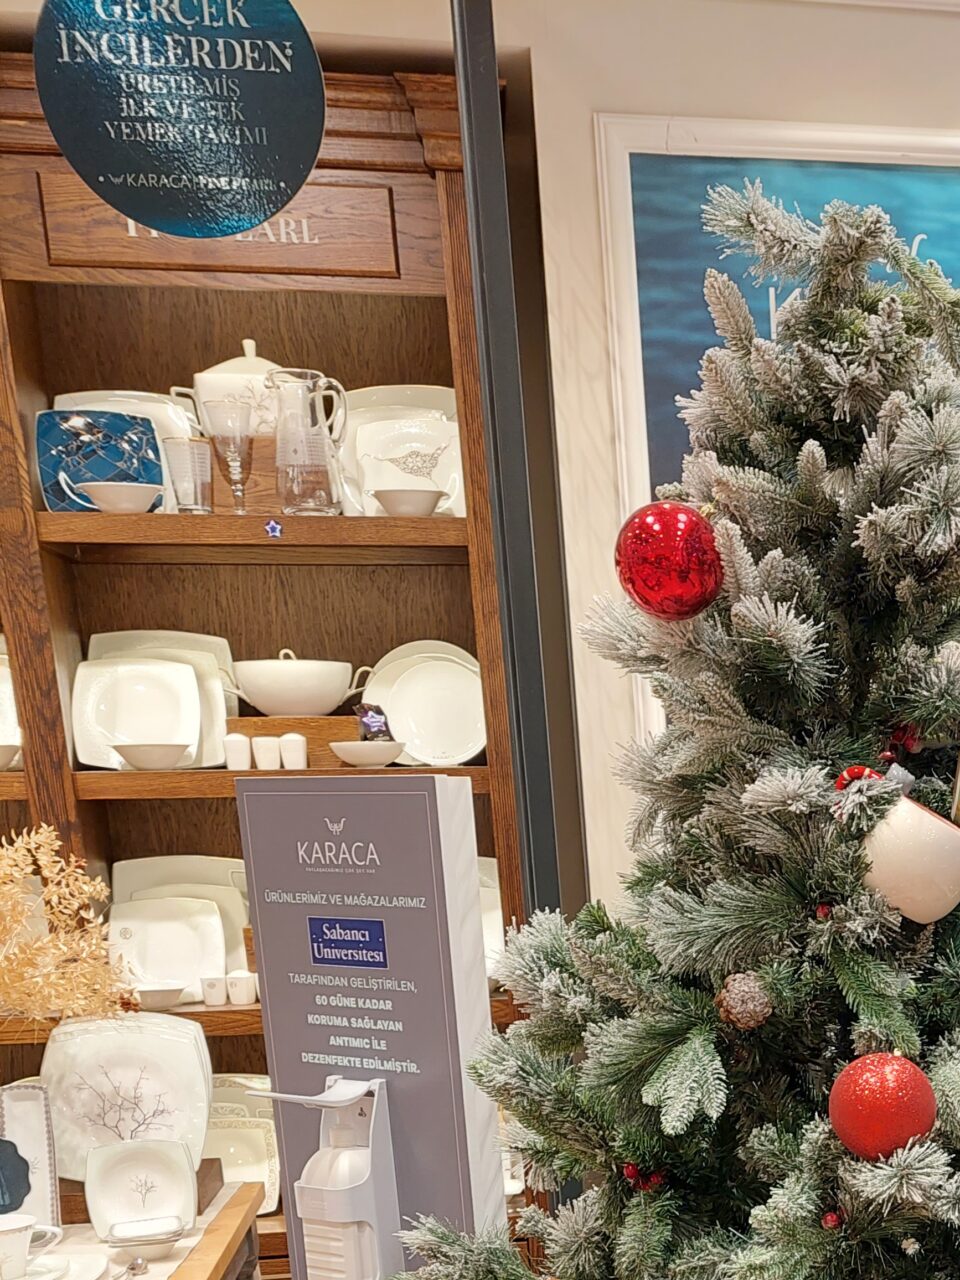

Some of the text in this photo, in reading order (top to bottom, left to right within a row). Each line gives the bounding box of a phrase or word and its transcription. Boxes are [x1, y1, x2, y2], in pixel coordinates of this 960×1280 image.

[94, 0, 251, 31] GERÇEK
[57, 22, 292, 73] İNCİLERDEN
[126, 173, 191, 188] KARACA
[297, 841, 381, 866] KARACA
[264, 890, 427, 908] ÜRÜNLERİMİZ VE MAĞAZALARIMIZ
[322, 923, 370, 941] Sabancı
[312, 935, 385, 962] Üniversitesi
[288, 973, 418, 993] TARAFINDAN GELİŞTİRİLEN,
[315, 994, 393, 1010] 60 GÜNE KADAR
[307, 1014, 403, 1032] KORUMA SAĞLAYAN
[329, 1036, 387, 1050] ANTIMIC İLE
[301, 1052, 421, 1073] DEZENFEKTE EDİLMİŞTİR.
